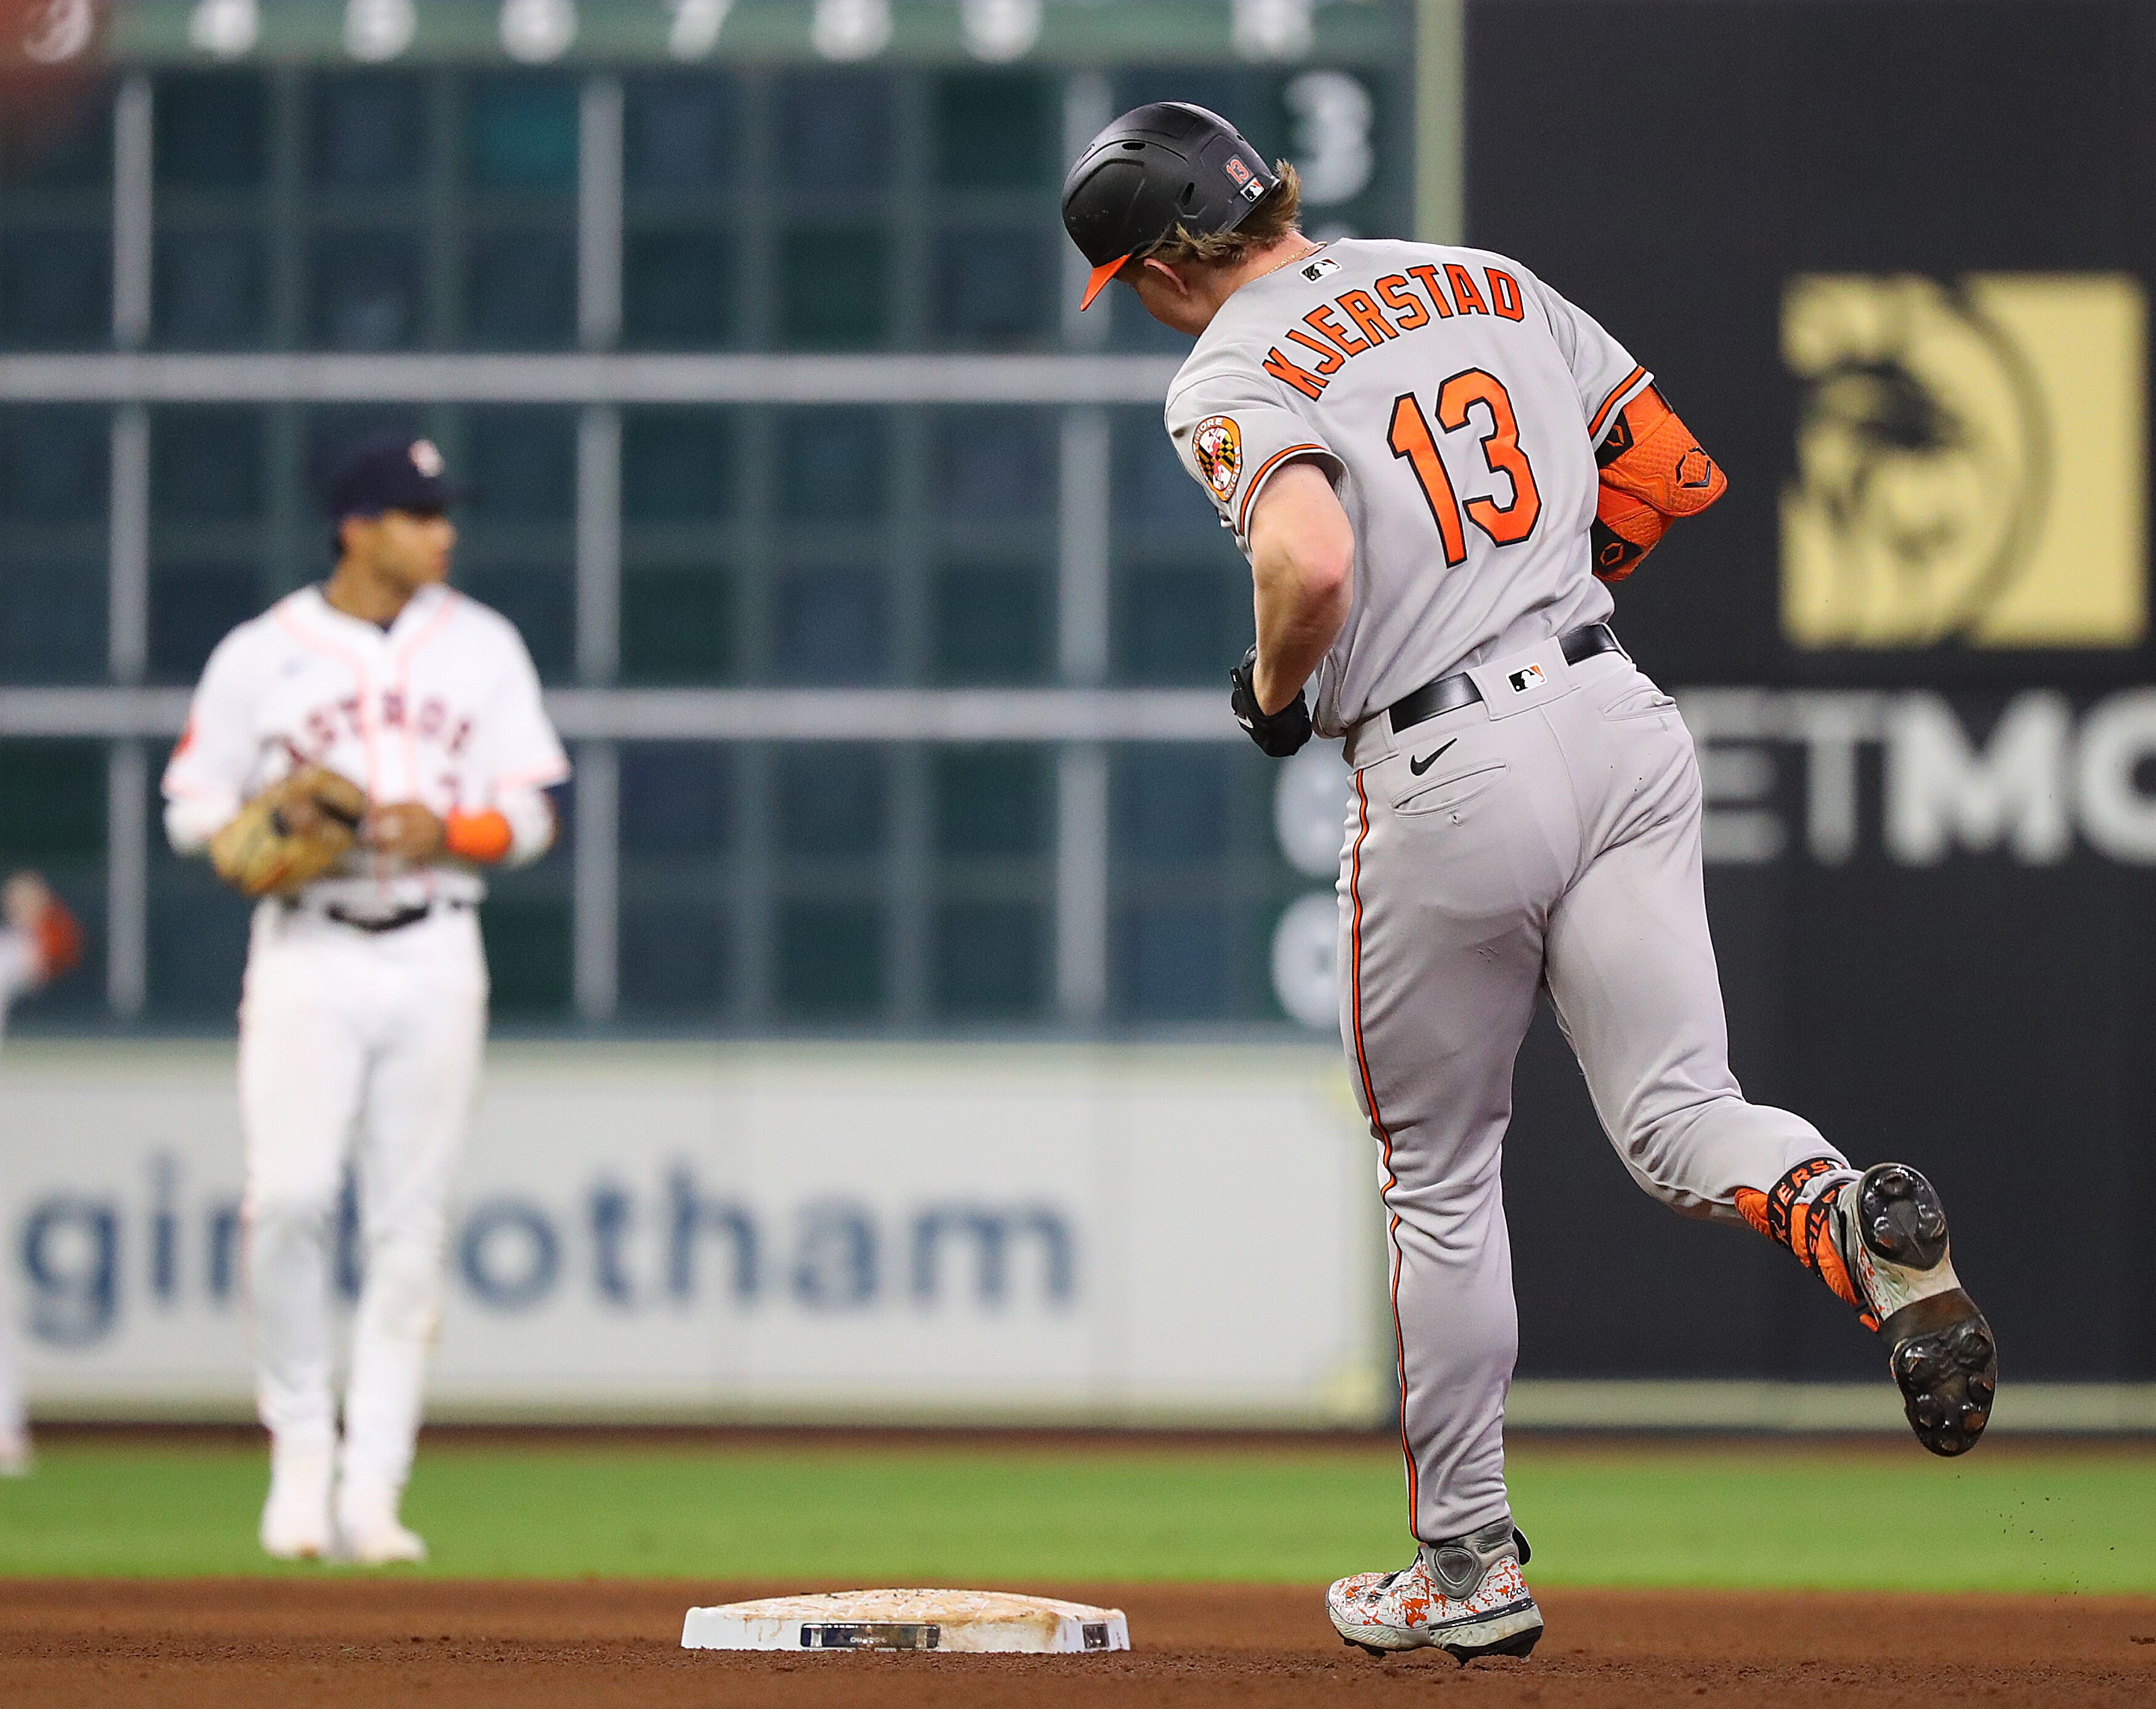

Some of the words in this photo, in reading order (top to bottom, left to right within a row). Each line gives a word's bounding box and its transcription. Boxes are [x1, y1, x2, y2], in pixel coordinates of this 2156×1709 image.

[1226, 159, 1249, 185] 13
[1284, 71, 1374, 205] 3
[1262, 263, 1525, 402] KJERSTAD
[1387, 367, 1541, 569] 13
